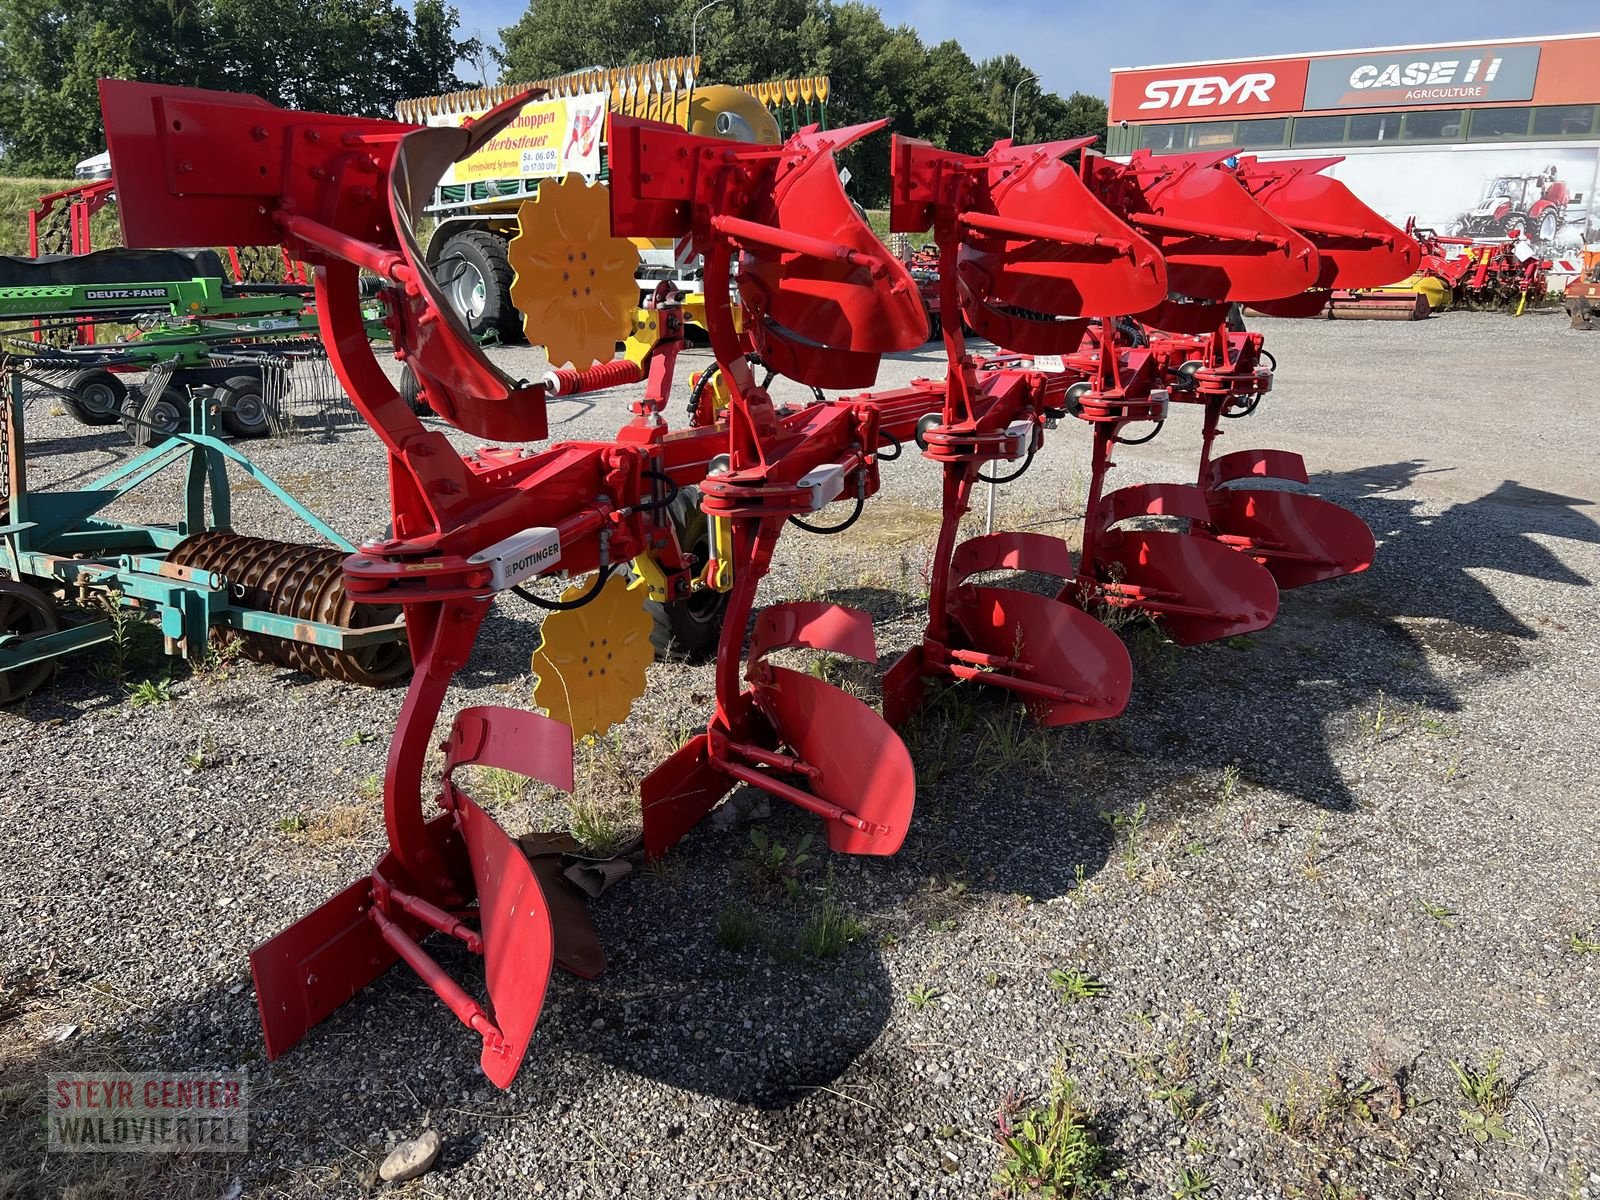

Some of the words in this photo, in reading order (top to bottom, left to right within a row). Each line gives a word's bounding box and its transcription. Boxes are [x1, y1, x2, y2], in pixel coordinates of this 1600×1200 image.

[1350, 60, 1459, 89] CASE
[1138, 72, 1276, 110] STEYR
[1405, 87, 1482, 99] AGRICULTURE
[487, 135, 549, 152] Herbstfeuer
[535, 150, 557, 161] 06.09.
[87, 289, 166, 299] DEUTZ-FAHR
